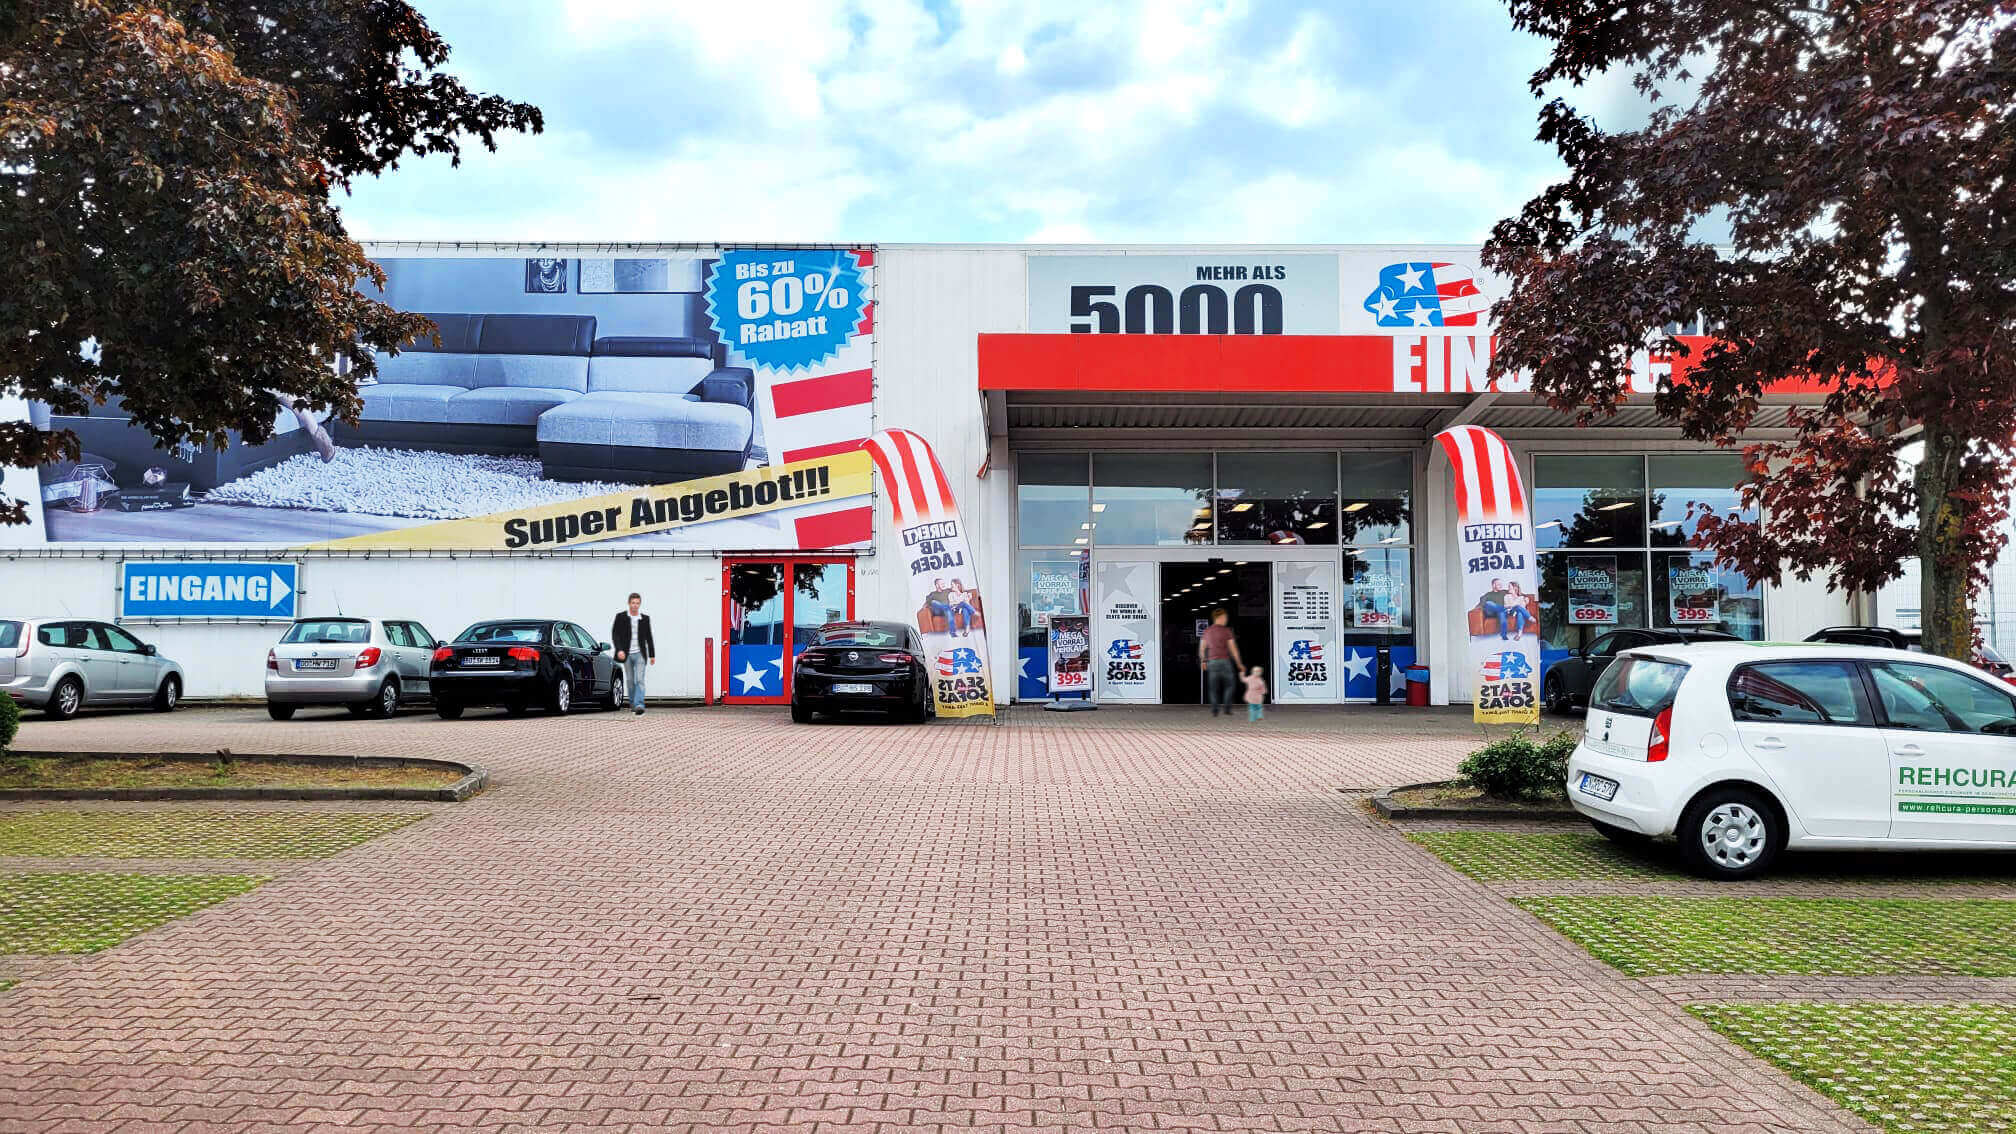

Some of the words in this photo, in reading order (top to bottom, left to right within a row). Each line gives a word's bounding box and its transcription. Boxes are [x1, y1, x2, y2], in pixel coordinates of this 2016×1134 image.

[736, 262, 769, 280] Bis
[772, 260, 795, 276] zu
[1196, 265, 1247, 281] MEHR
[1252, 265, 1286, 280] ALS
[737, 270, 849, 320] 60%
[1070, 283, 1283, 335] 5000
[740, 315, 828, 345] Rabatt
[504, 505, 623, 549] Super
[629, 466, 830, 529] Angebot!!!
[130, 575, 268, 601] EINGANG
[1059, 631, 1083, 639] MEGA
[1108, 661, 1145, 671] SEATS
[1290, 662, 1326, 671] SEATS
[1107, 671, 1146, 681] SOFAS
[1288, 671, 1327, 681] SOFAS
